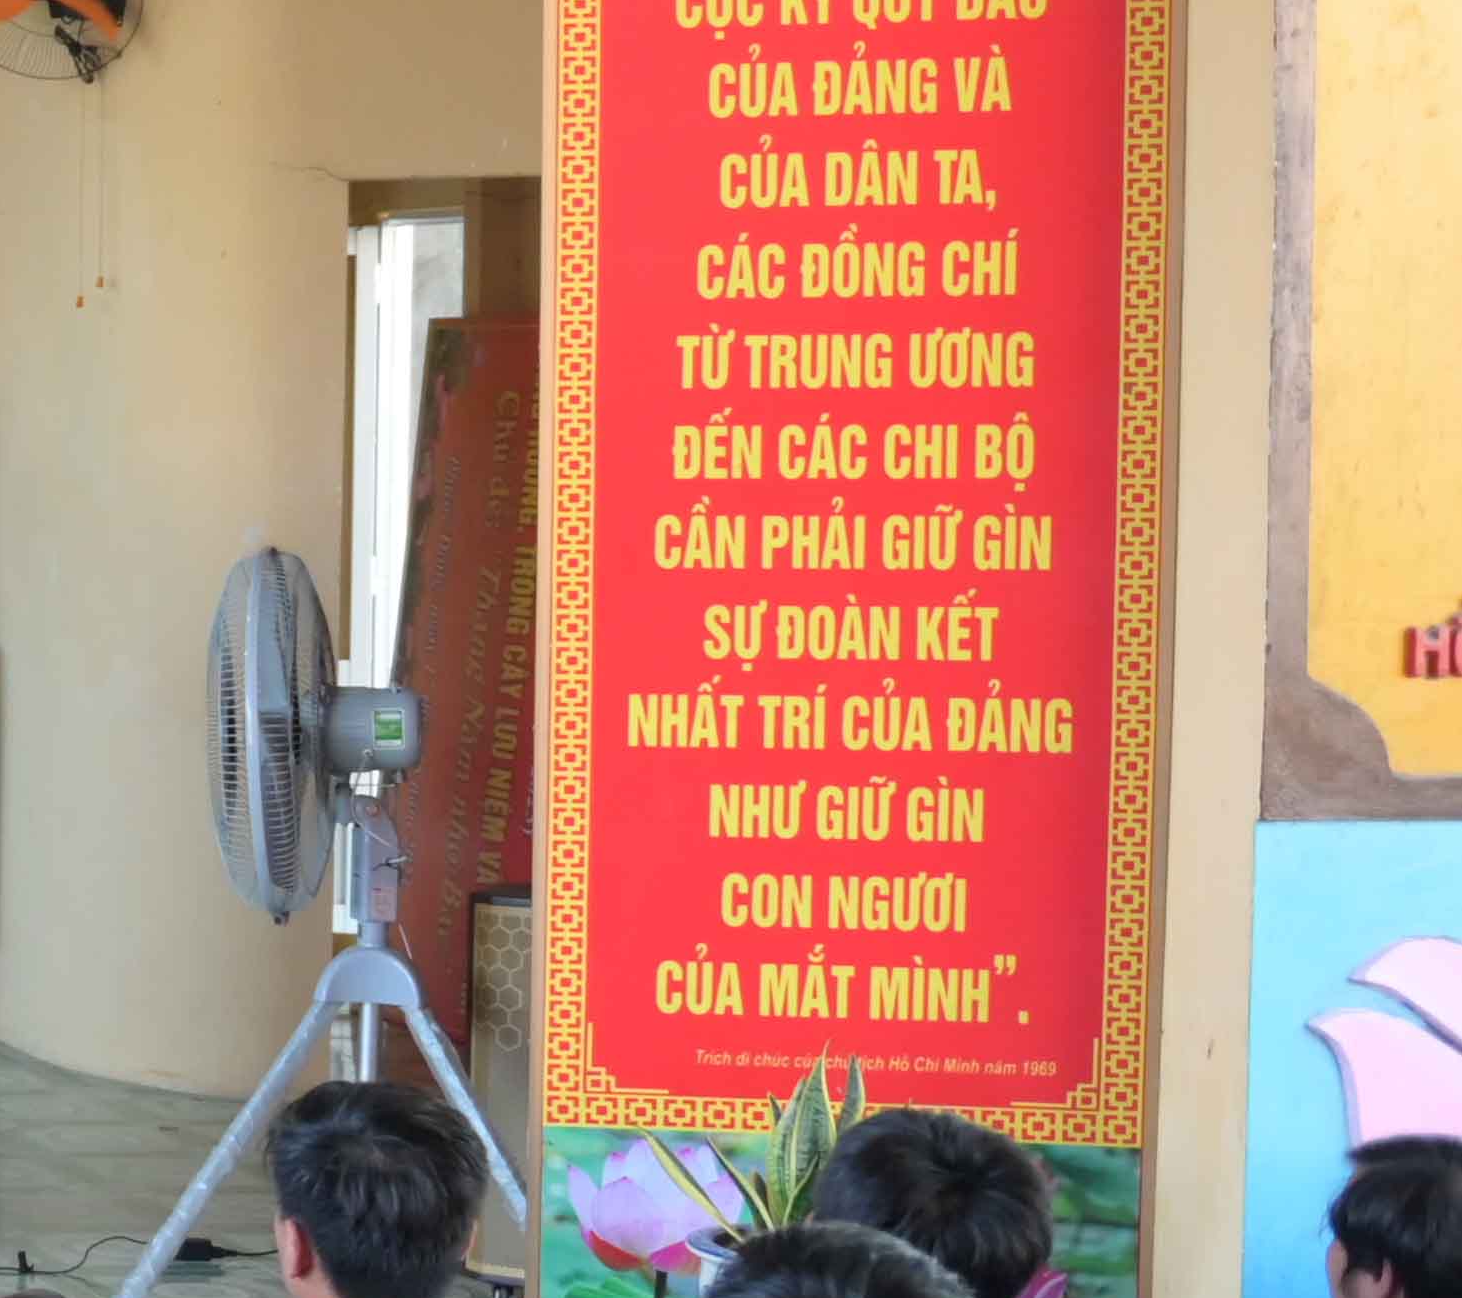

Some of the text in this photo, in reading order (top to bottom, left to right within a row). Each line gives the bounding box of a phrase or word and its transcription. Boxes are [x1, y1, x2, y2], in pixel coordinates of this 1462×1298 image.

[673, 408, 1034, 491] ĐẾN CÁC CHI BỘ
[1404, 611, 1462, 679] H
[657, 943, 743, 1015] CỦA
[760, 944, 855, 1018] MẮT
[945, 1057, 980, 1075] Minh
[1022, 1061, 1056, 1077] 1969
